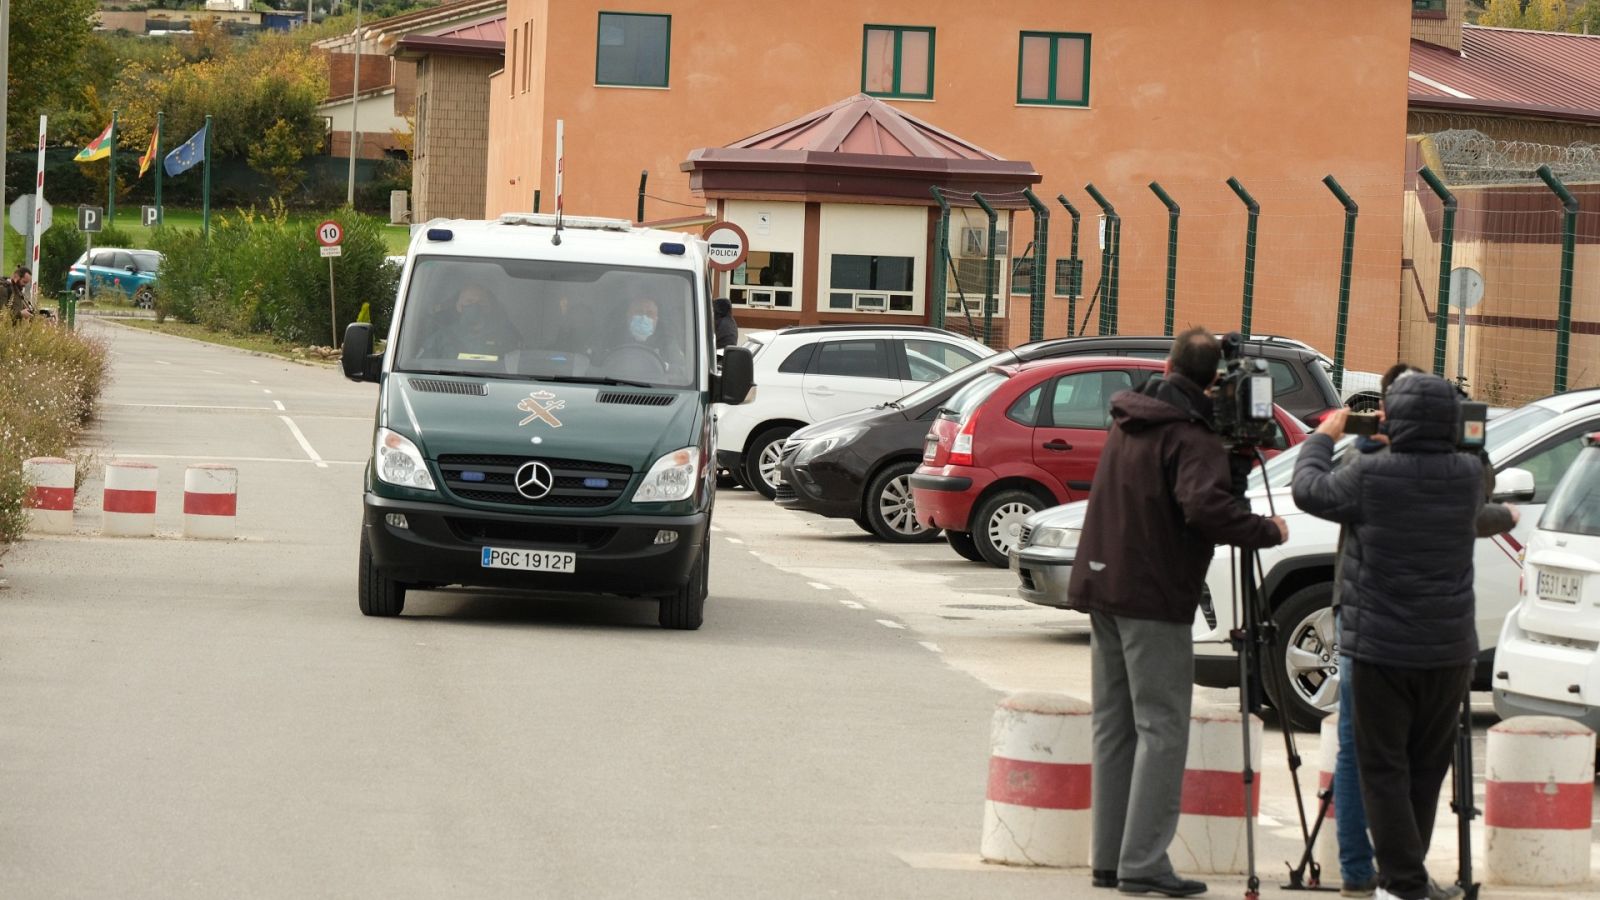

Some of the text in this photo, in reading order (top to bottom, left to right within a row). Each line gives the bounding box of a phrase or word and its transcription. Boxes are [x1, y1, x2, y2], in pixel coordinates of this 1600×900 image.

[84, 209, 96, 229] P
[147, 207, 157, 225] P
[322, 228, 337, 239] 10
[710, 249, 738, 257] POLICIA
[490, 550, 520, 567] PGC
